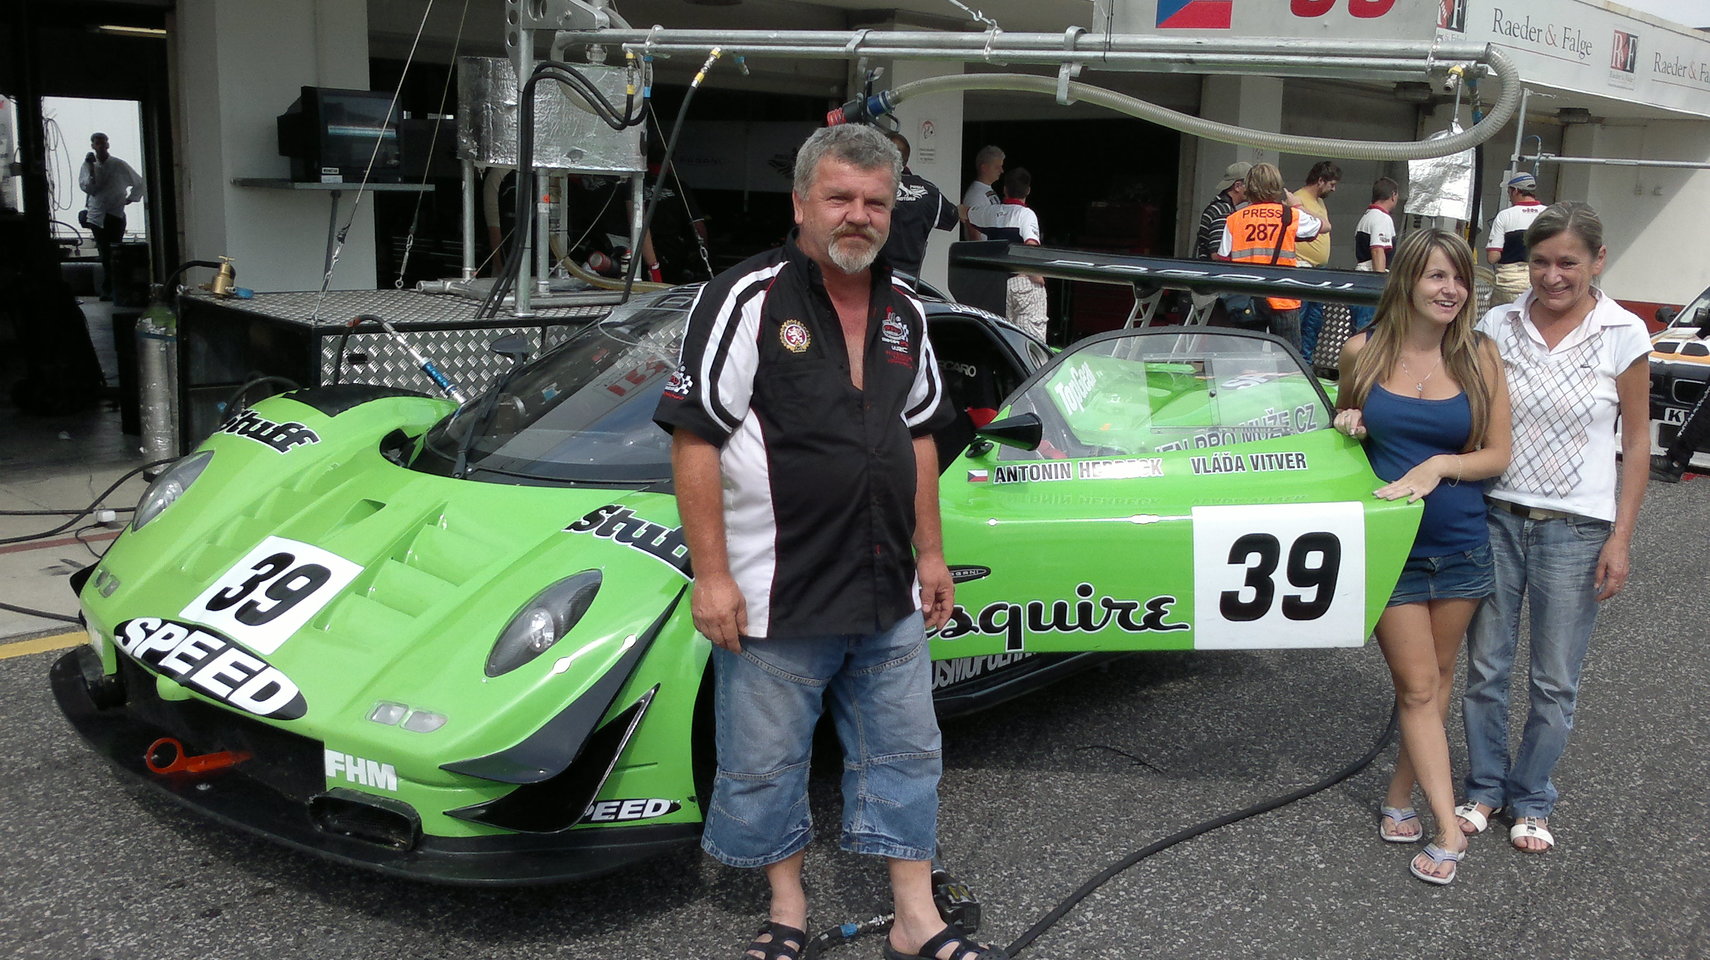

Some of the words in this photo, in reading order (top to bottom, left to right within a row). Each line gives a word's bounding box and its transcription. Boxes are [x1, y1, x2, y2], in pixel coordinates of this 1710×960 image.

[1492, 8, 1543, 43] Raeder
[1545, 24, 1557, 47] &
[1562, 26, 1593, 59] Falge
[1653, 51, 1688, 77] Raeder
[1688, 60, 1697, 80] &
[1242, 208, 1282, 219] PRESS
[1245, 223, 1279, 242] 287
[1054, 361, 1097, 416] TopGear
[219, 409, 321, 454] Stuff
[994, 462, 1072, 483] ANTONIN
[1191, 451, 1245, 474] VLÁĎA
[1250, 453, 1307, 472] VITVER
[205, 551, 332, 626] 39
[1219, 532, 1341, 622] 39
[927, 583, 1190, 651] squire
[115, 617, 300, 716] SPEED
[324, 750, 399, 791] FHM
